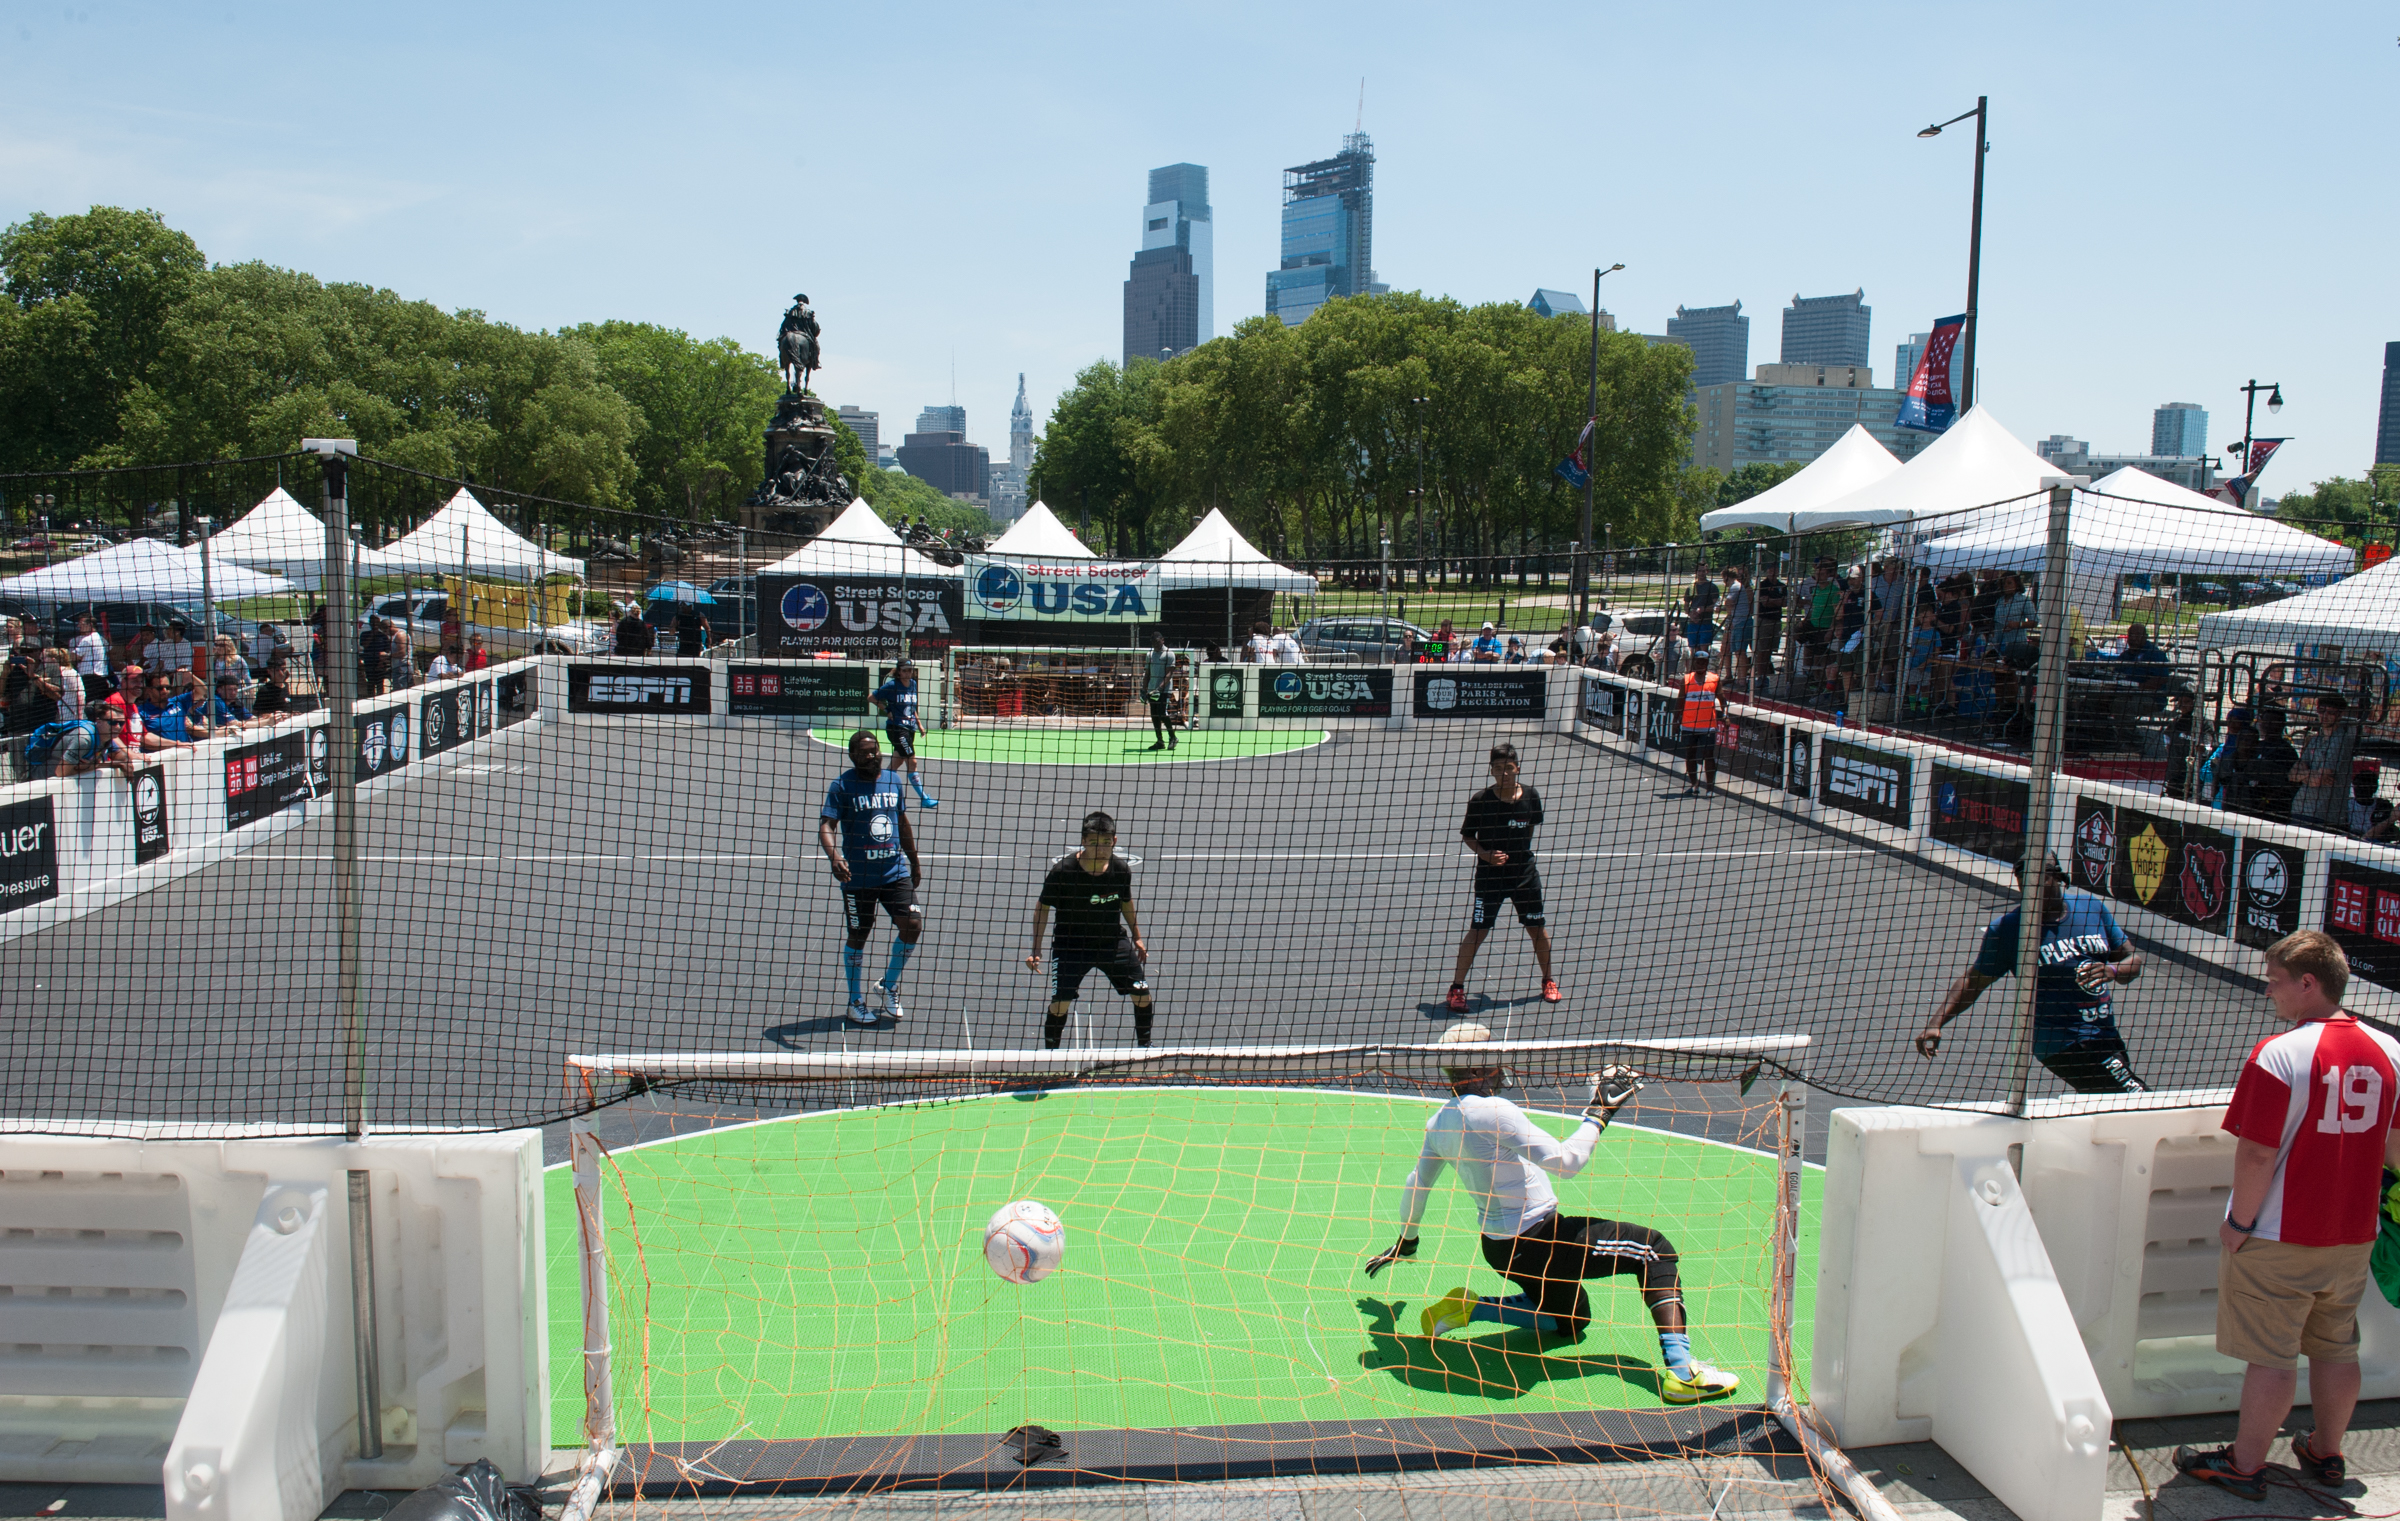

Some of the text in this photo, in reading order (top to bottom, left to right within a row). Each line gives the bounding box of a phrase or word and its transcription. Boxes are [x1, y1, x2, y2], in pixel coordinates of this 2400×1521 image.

[1027, 564, 1149, 579] Street Soccer
[834, 585, 943, 601] Street Soccer
[1026, 583, 1149, 616] USA
[835, 600, 953, 634] USA
[780, 636, 820, 647] PLAYING
[821, 636, 842, 647] FOR
[761, 676, 778, 685] UNI
[1305, 672, 1369, 681] Street Soccer
[588, 675, 692, 704] ESPN
[761, 685, 779, 694] QLO
[814, 688, 837, 697] made
[1305, 681, 1375, 700] USA
[1461, 689, 1496, 697] PARKS
[1260, 705, 1287, 713] PLAYING
[1288, 705, 1302, 713] FOR
[1328, 705, 1351, 713] GOALS
[1461, 698, 1531, 706] RECREATION
[246, 759, 257, 773] UNI
[246, 773, 258, 788] QLO
[1829, 754, 1900, 809] ESPN
[858, 793, 881, 811] PLAY
[0, 822, 48, 858] uer
[865, 849, 897, 861] USA
[2136, 858, 2158, 879] HOPE
[2190, 854, 2214, 907] FAMILY
[2247, 913, 2281, 933] USA
[2040, 937, 2081, 966] PLAY
[2317, 1065, 2383, 1134] 19
